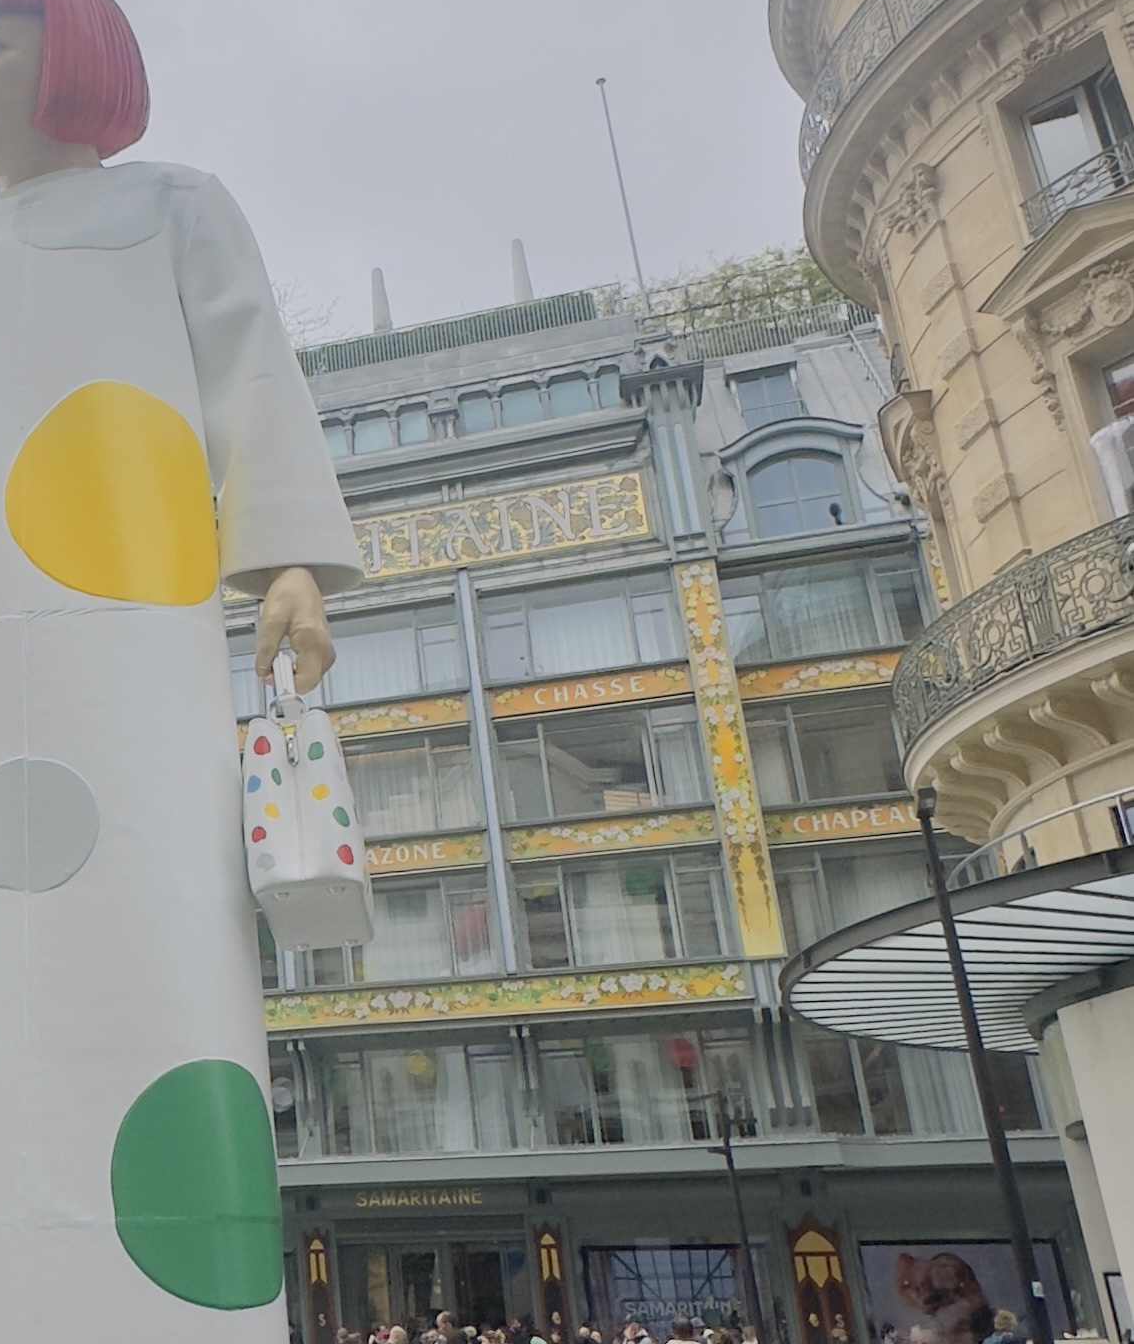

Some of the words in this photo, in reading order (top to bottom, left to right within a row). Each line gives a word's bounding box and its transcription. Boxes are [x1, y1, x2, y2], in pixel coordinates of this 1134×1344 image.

[365, 482, 629, 573] ITAINE
[533, 675, 645, 705] CHASSE
[356, 1187, 483, 1207] SAMARITAINE
